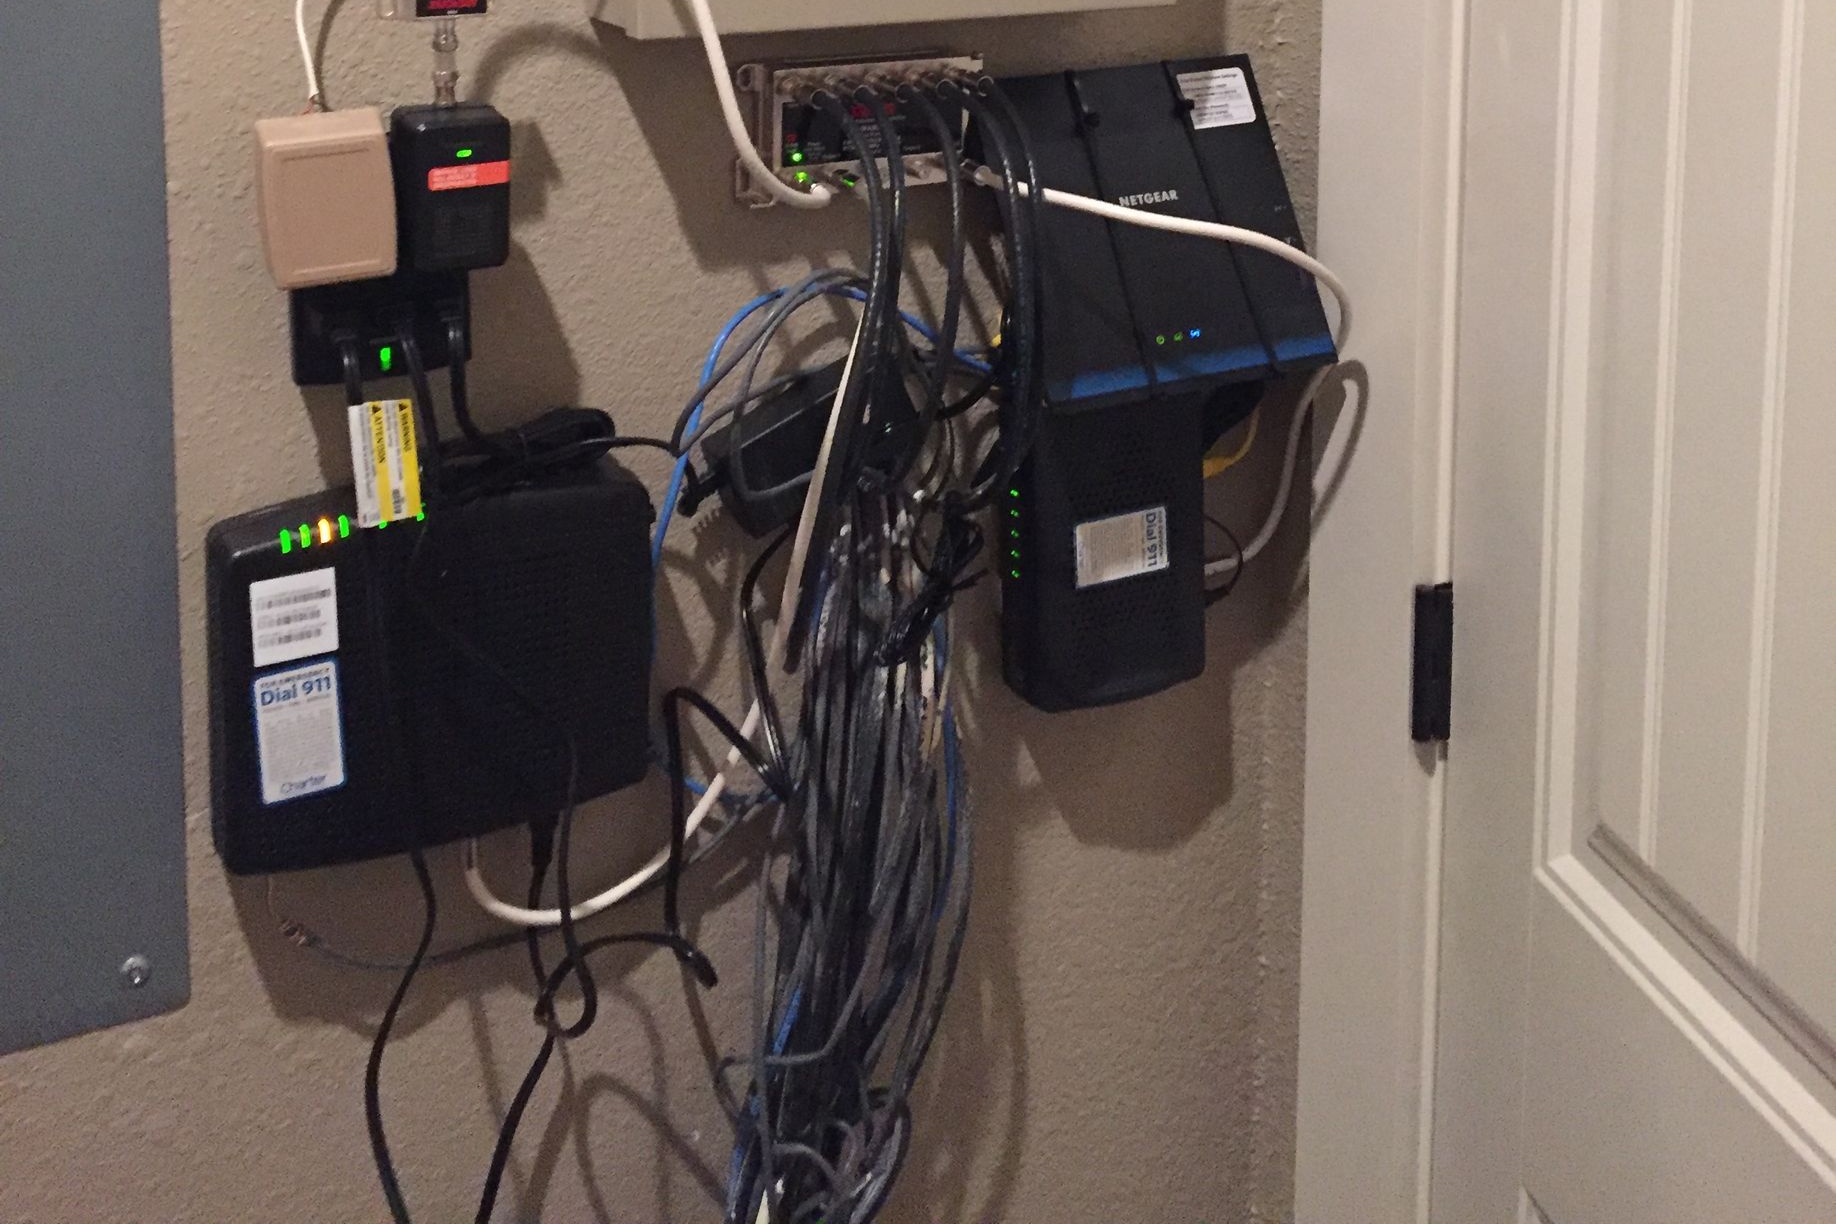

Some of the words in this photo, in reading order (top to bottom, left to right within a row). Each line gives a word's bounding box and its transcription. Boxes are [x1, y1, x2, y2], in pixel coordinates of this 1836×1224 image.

[1118, 189, 1179, 208] NETGEAR
[1145, 512, 1157, 541] Dial
[1147, 542, 1158, 567] 911
[260, 683, 298, 707] Dial
[302, 676, 332, 695] 911
